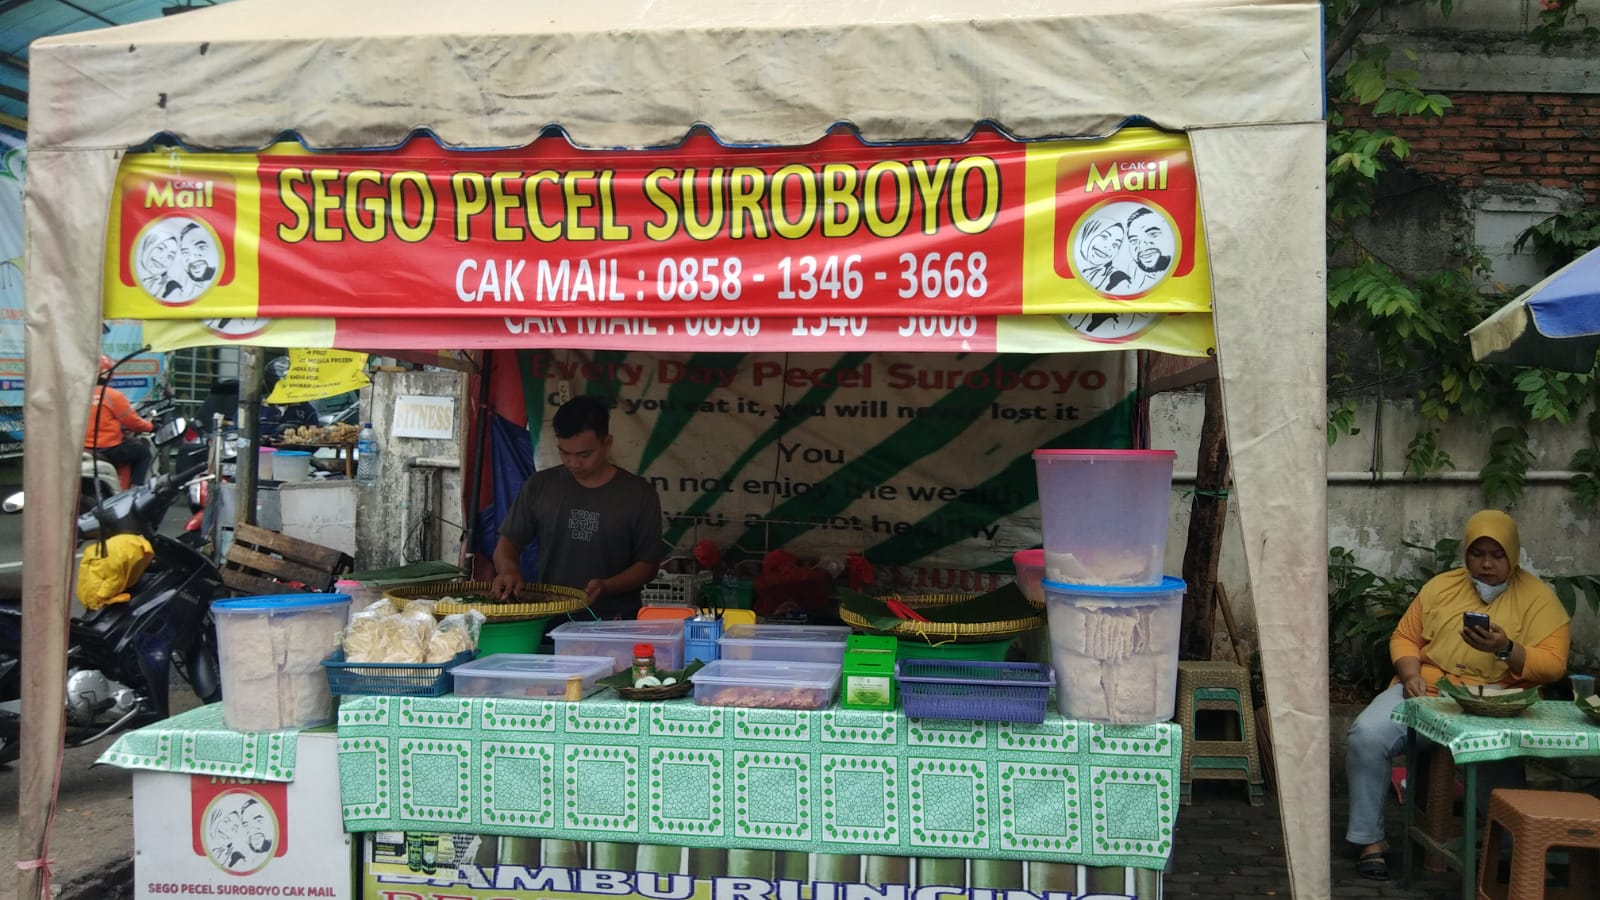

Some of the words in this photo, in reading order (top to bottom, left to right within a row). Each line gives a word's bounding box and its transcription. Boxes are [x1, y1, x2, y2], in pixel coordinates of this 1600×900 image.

[1120, 161, 1145, 171] CAK
[1084, 159, 1169, 193] Mail
[144, 179, 214, 209] Mail
[174, 181, 195, 190] CAK
[276, 166, 438, 244] SEGO
[450, 168, 632, 243] PECEL
[642, 154, 1002, 242] SUROBOYO
[454, 258, 526, 303] CAK
[536, 258, 625, 301] MAIL
[656, 256, 742, 301] 0858
[777, 254, 864, 300] 1346
[898, 251, 988, 300] 3668
[530, 354, 643, 386] Every
[658, 359, 739, 388] Day
[752, 361, 872, 389] Pecel
[888, 363, 1106, 394] Suroboyo
[834, 401, 888, 418] will
[992, 402, 1047, 420] lost
[1056, 402, 1080, 420] it
[779, 443, 845, 465] You
[680, 476, 733, 494] not
[569, 509, 600, 520] TODAY
[568, 518, 579, 529] IS
[579, 520, 600, 532] THE
[571, 529, 594, 542] DAY
[148, 883, 179, 894] SEGO
[181, 883, 214, 895] PECEL
[217, 884, 280, 896] SUROBOYO
[282, 886, 305, 897] CAK
[307, 886, 336, 898] MAIL
